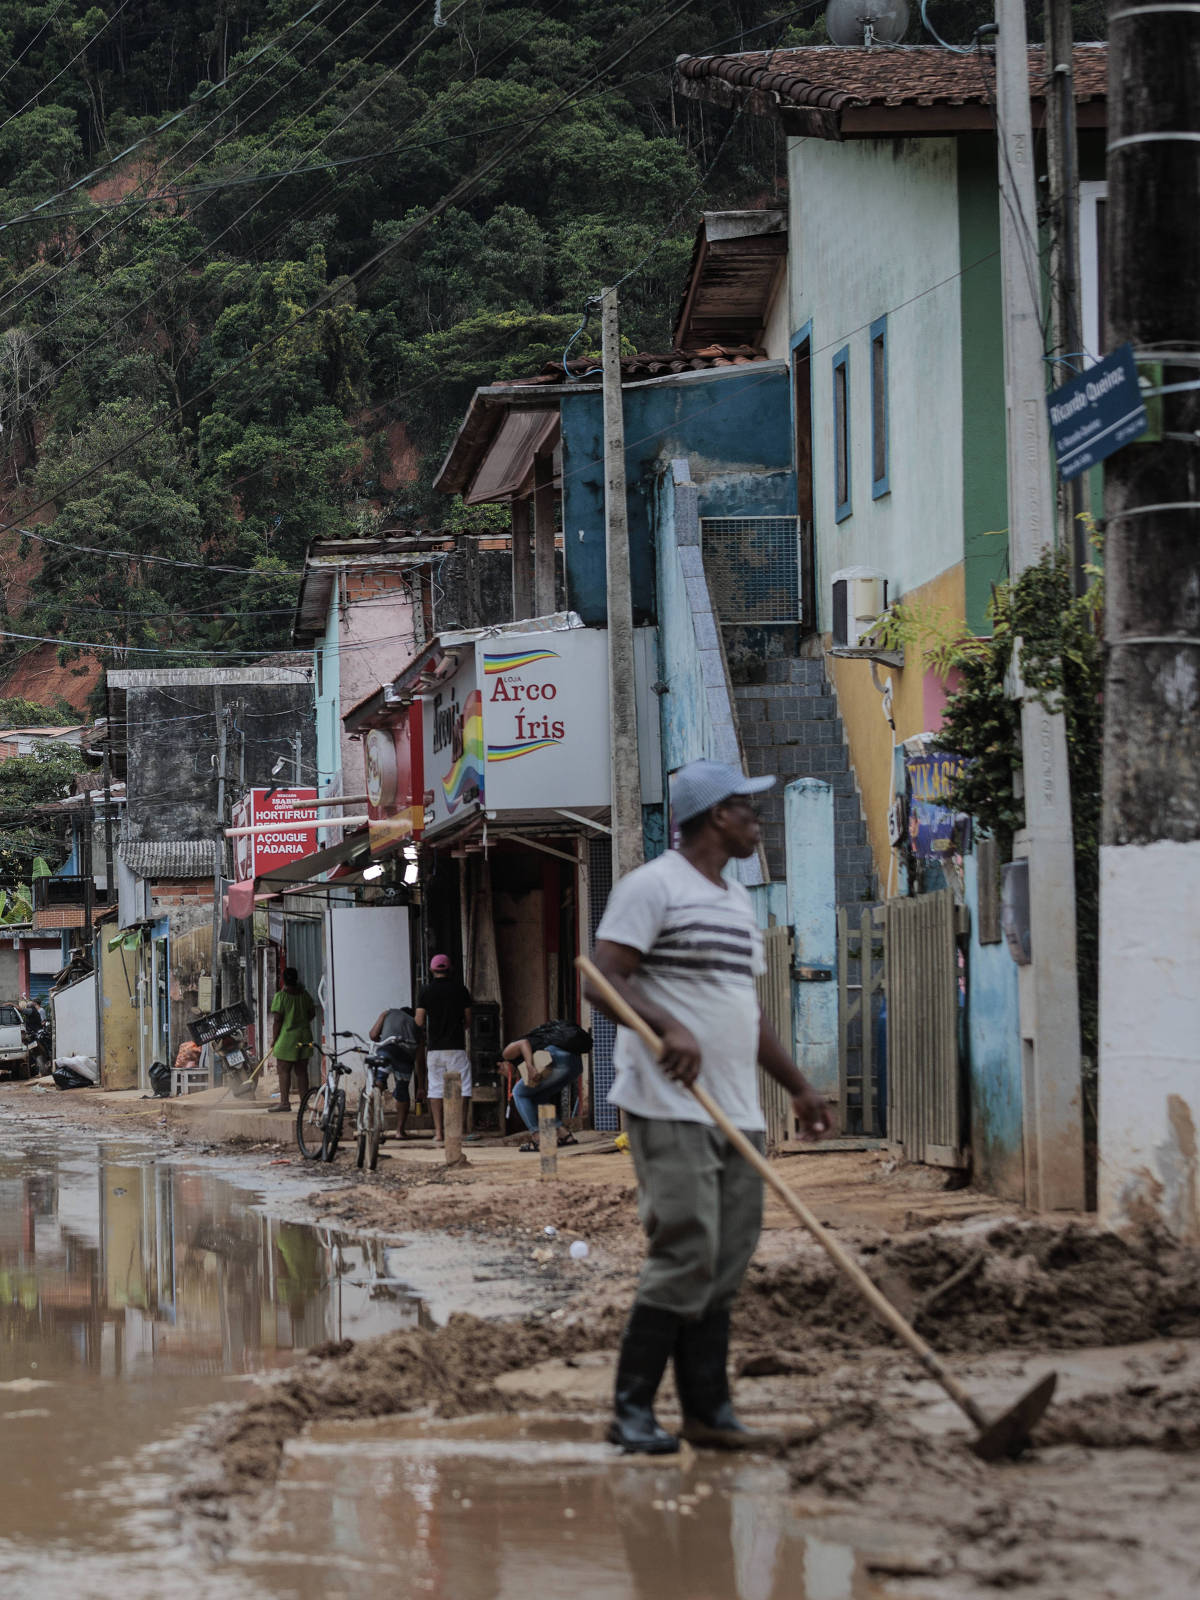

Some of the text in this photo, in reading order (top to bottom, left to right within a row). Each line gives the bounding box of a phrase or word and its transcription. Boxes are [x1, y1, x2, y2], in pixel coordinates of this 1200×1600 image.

[1050, 366, 1126, 425] Ricardo Queiroz
[490, 676, 557, 702] Arco
[514, 706, 566, 740] Íris
[256, 810, 317, 820] HORTIFRUTI
[256, 833, 308, 845] AÇOUGUE
[256, 844, 304, 854] PADARIA
